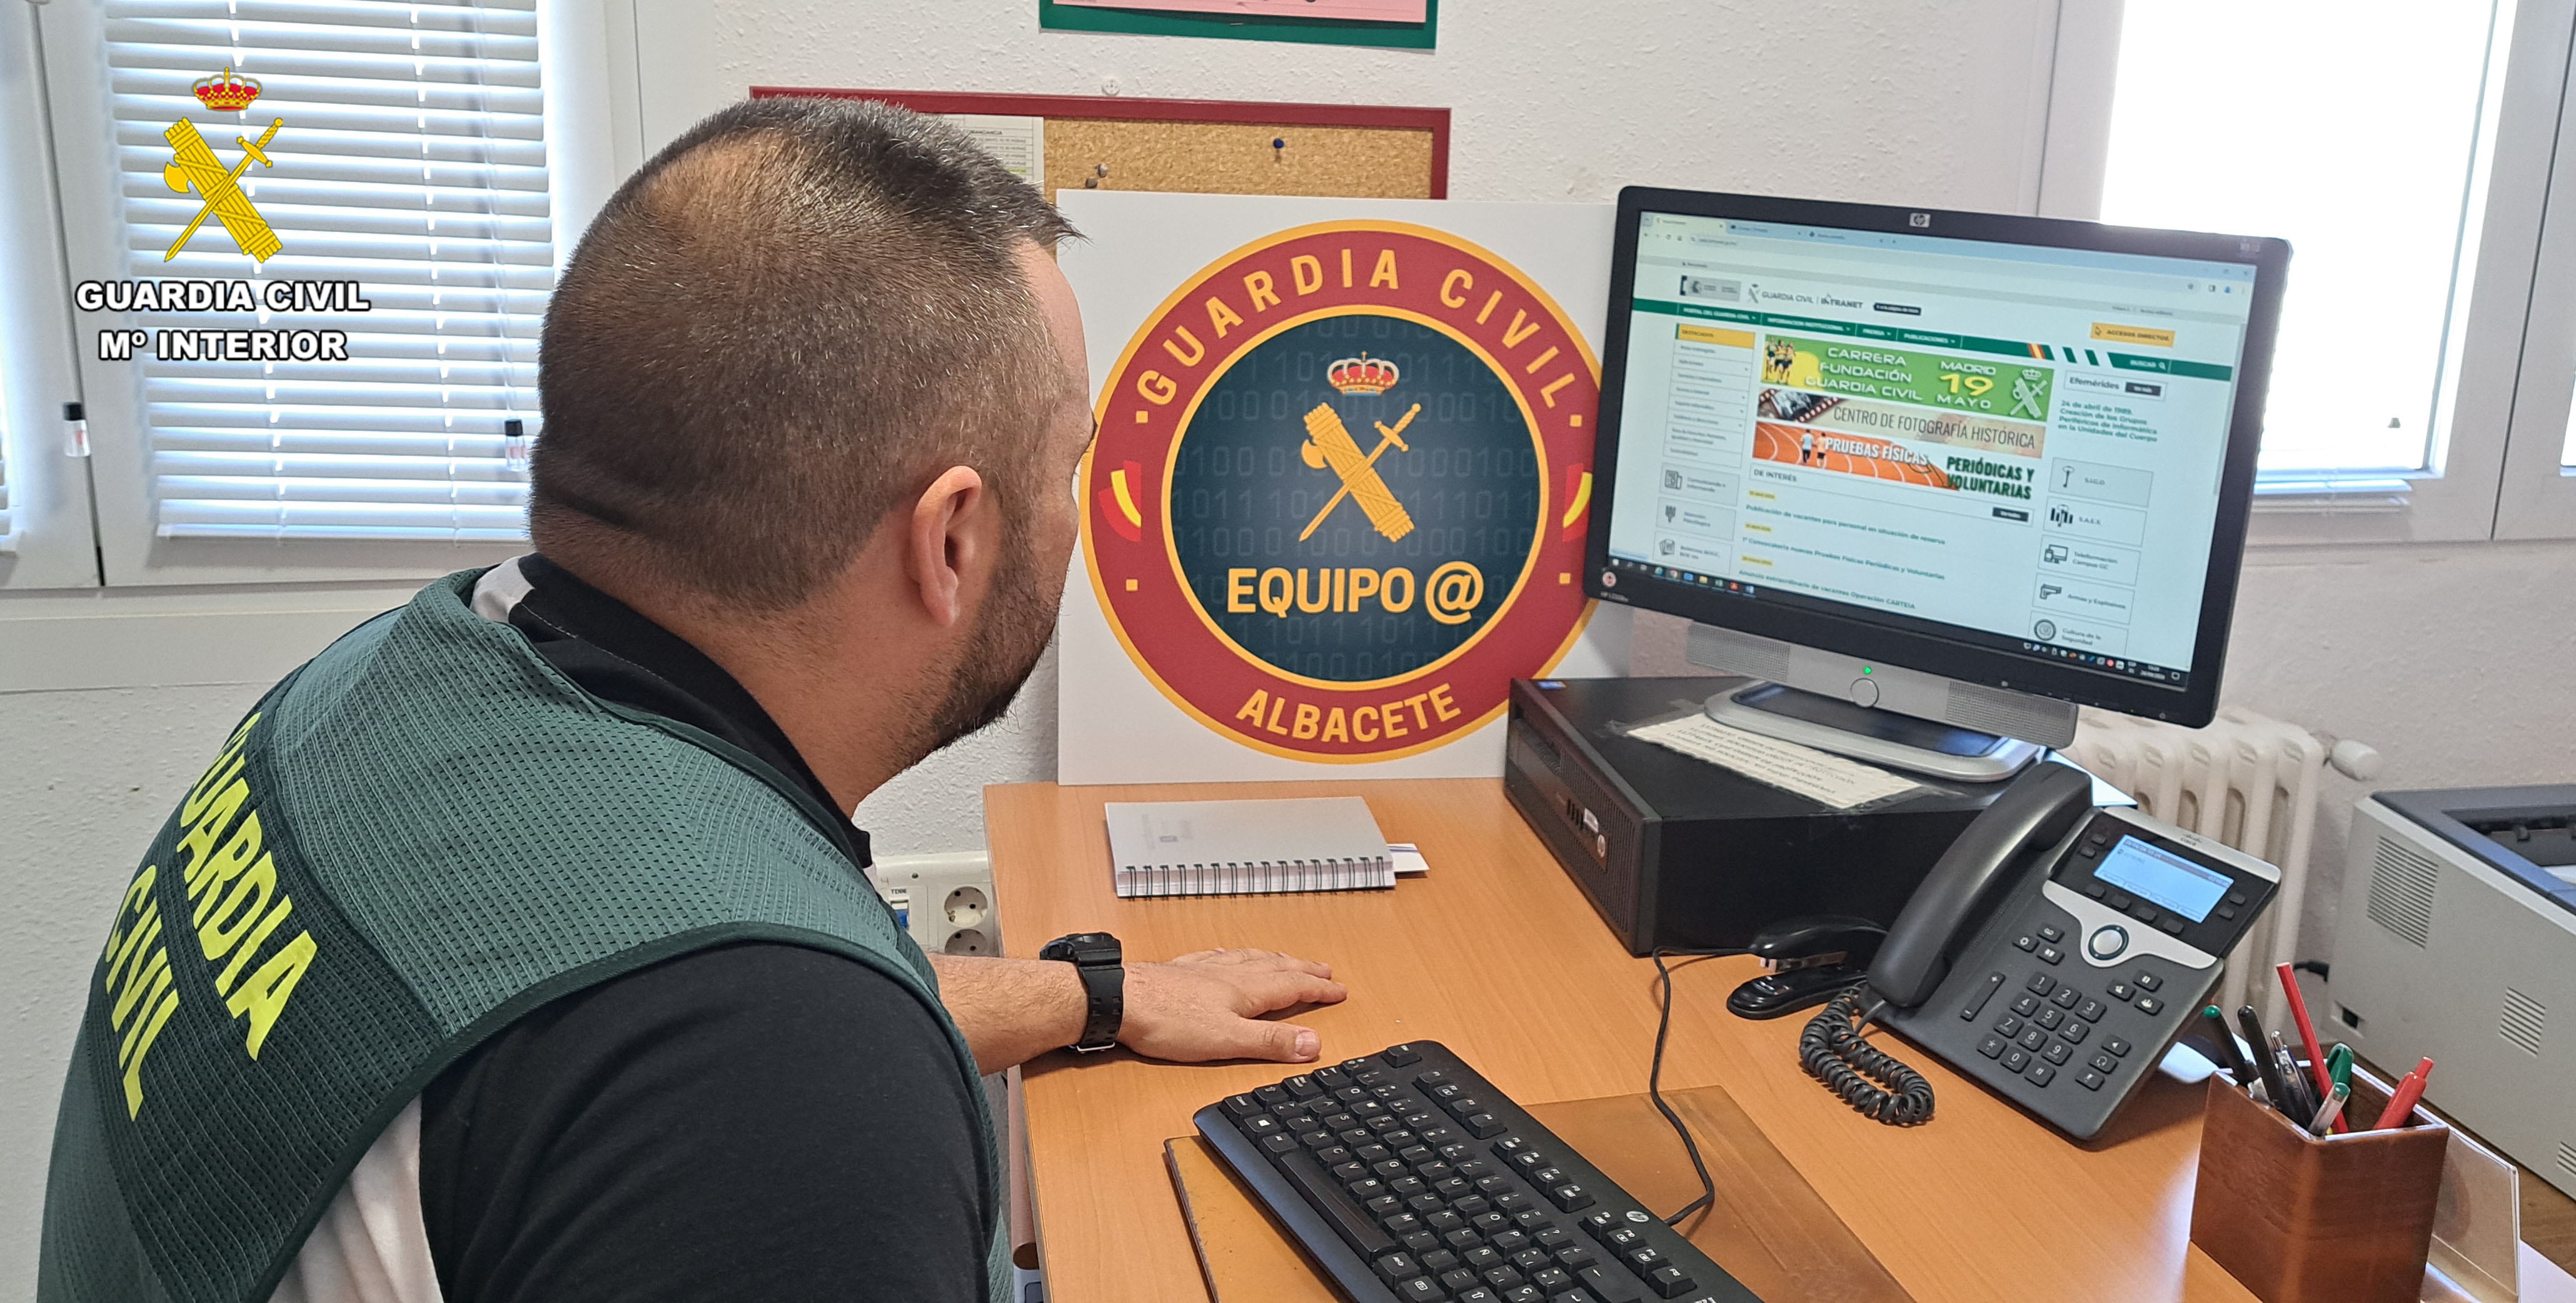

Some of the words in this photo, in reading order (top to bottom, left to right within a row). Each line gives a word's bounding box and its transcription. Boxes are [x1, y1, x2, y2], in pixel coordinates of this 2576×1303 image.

[1761, 291, 1794, 301] GUARDIA
[1796, 294, 1813, 304] CIVIL
[1820, 296, 1863, 309] INTRANET
[1137, 248, 1399, 406] GUARDIA
[1439, 268, 1577, 409] CIVIL
[1827, 347, 1907, 367] CARRERA
[1819, 361, 1913, 383] FUNDACIÓN
[1940, 360, 1998, 376] MADRID
[1804, 375, 1876, 395] GUARDIA
[1881, 386, 1923, 402] CIVIL
[1938, 373, 1995, 396] 19
[2069, 376, 2120, 390] Efemérides
[1936, 393, 1992, 410] MAYO
[2060, 408, 2093, 418] Creación
[1833, 405, 1878, 426] CENTRO
[1879, 412, 1894, 428] DE
[1897, 415, 1969, 441] FOTOGRAFÍA
[1971, 426, 2036, 450] HISTÓRICA
[1824, 436, 1881, 458] PRUEBAS
[1883, 445, 1928, 466] FÍSICAS
[1754, 468, 1764, 476] DE
[1766, 471, 1797, 482] INTERÉS
[1946, 455, 2021, 481] PERIÓDICAS
[2026, 468, 2035, 483] Y
[1945, 473, 2032, 500] VOLUNTARIAS
[1746, 504, 1782, 516] Publicación
[1793, 514, 1821, 523] vacantes
[1838, 521, 1866, 531] personal
[1878, 527, 1909, 538] situación
[1920, 536, 1946, 545] reserva
[1814, 550, 1841, 561] Pruebas
[1906, 567, 1945, 580] Voluntarias
[1227, 566, 1415, 618] EQUIPO
[1424, 560, 1485, 626] @
[1821, 586, 1849, 596] vacantes
[1851, 591, 1884, 604] Operación
[1235, 683, 1462, 743] ALBACETE
[2038, 976, 2046, 985] 1
[105, 864, 179, 1122] CIVIL
[2021, 997, 2030, 1006] 4
[2061, 989, 2071, 999] 2
[2044, 1010, 2055, 1019] 5
[2086, 1002, 2096, 1011] 3
[2004, 1017, 2014, 1026] 7
[2069, 1023, 2079, 1033] 6
[2028, 1031, 2038, 1040] 8
[2011, 1052, 2021, 1062] 0
[2051, 1044, 2062, 1054] 9
[1382, 1196, 1395, 1204] N
[1442, 1211, 1454, 1219] K
